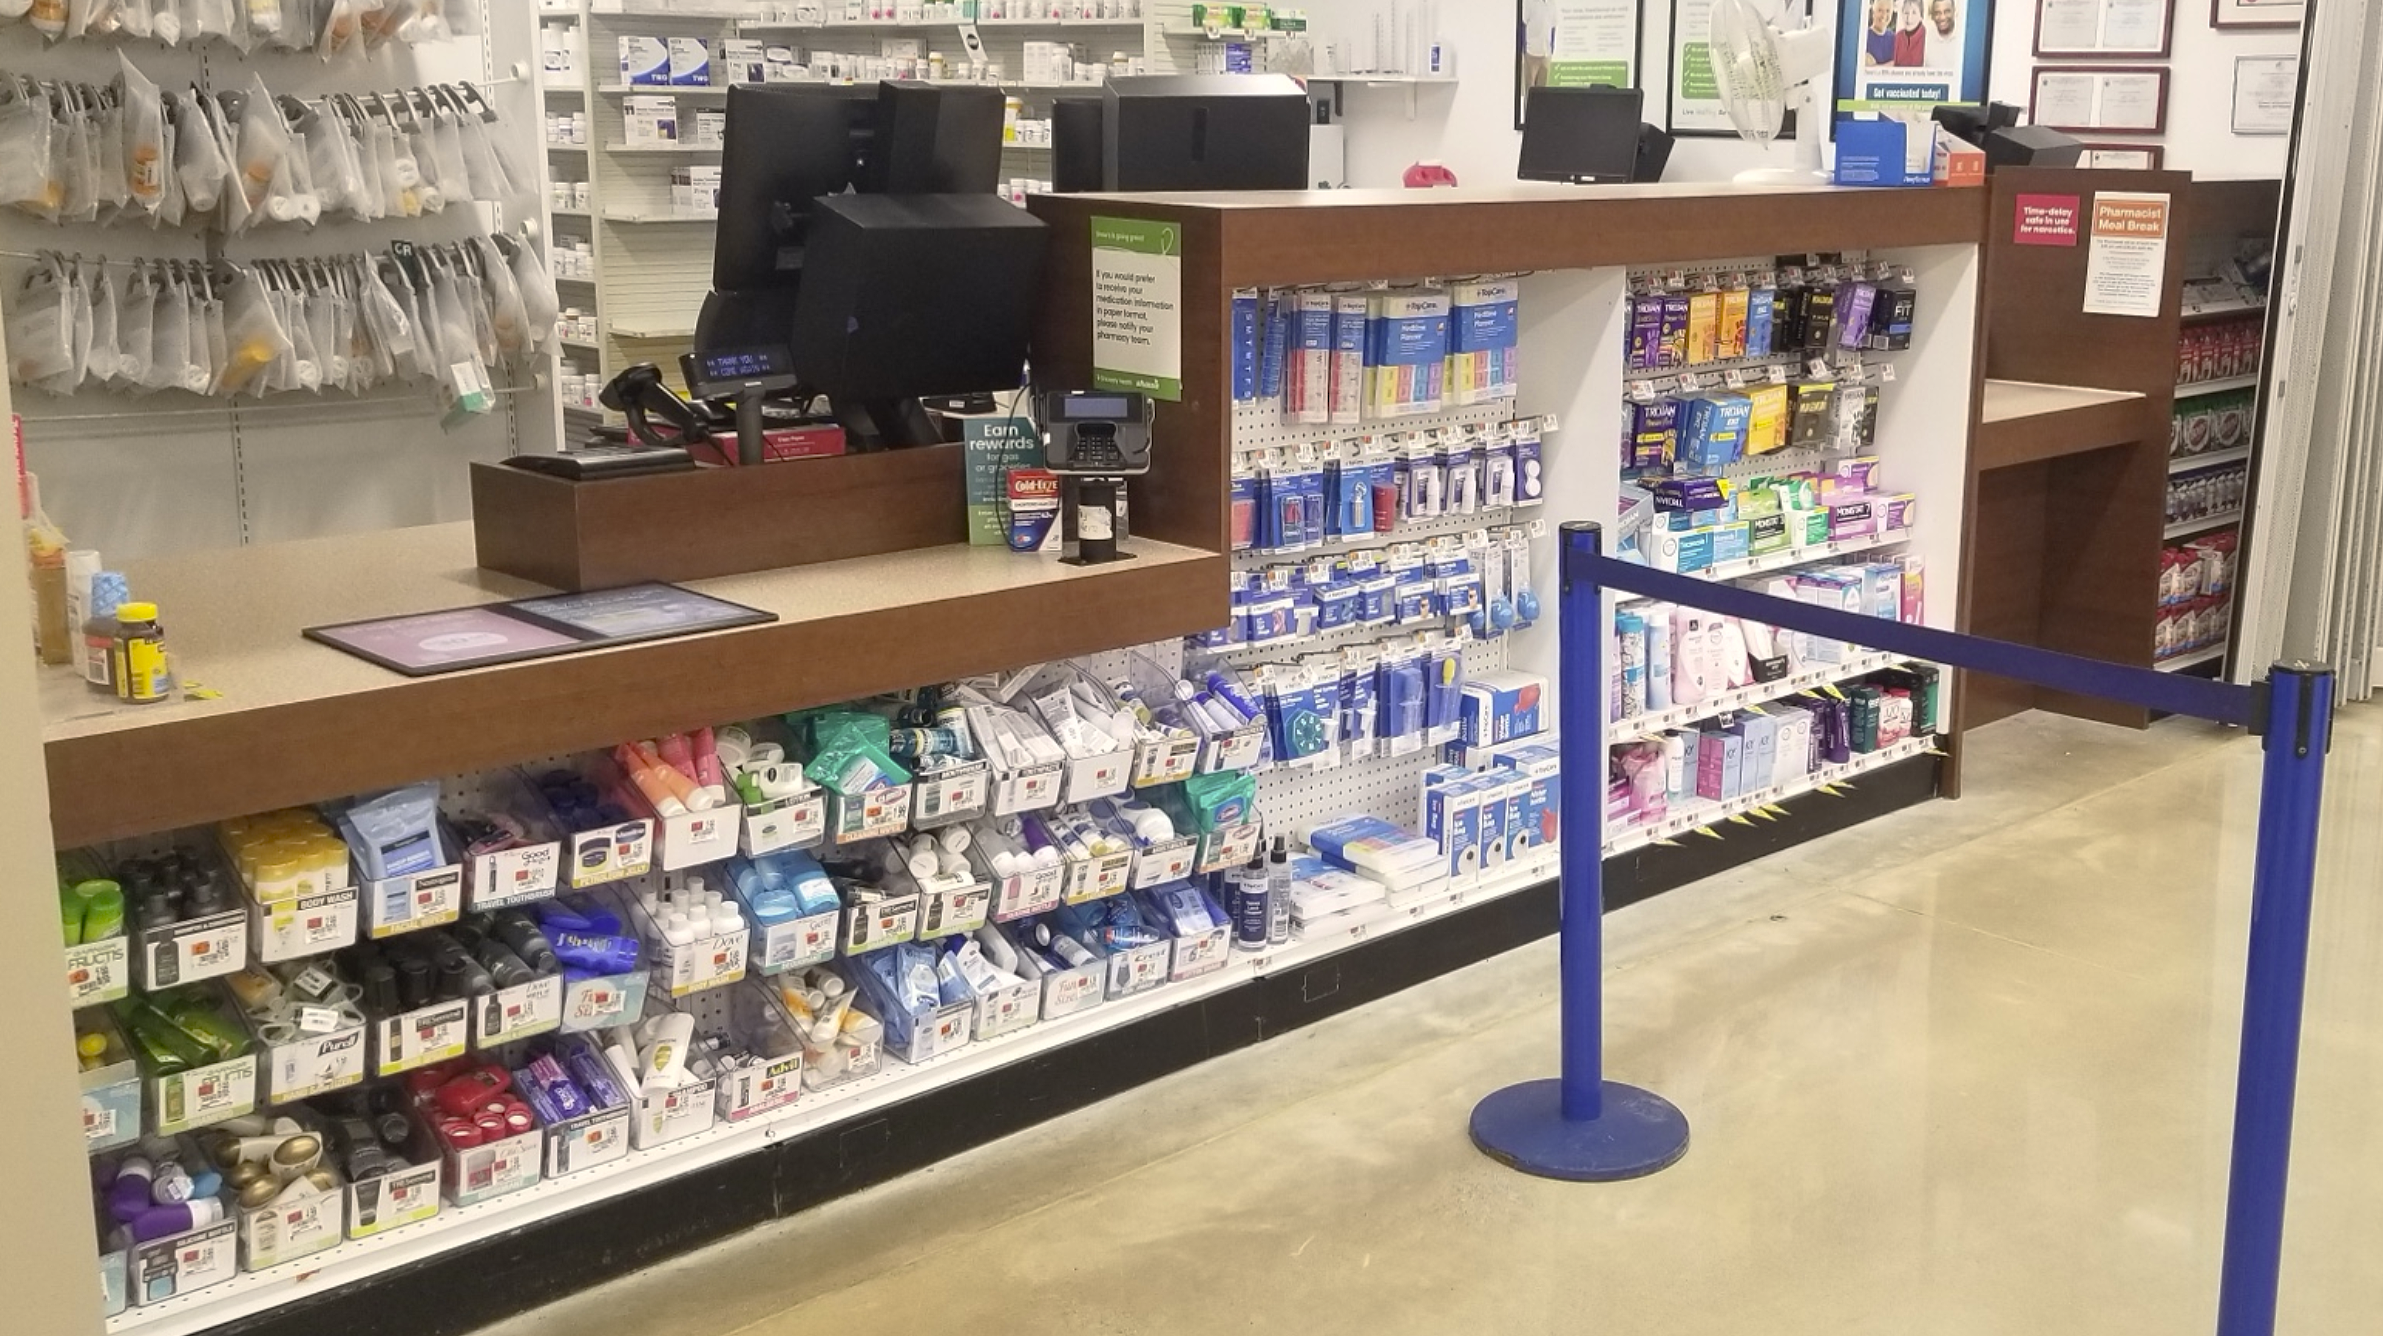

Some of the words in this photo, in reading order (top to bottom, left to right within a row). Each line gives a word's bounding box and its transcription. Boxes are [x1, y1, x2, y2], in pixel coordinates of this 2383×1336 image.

[1874, 88, 1884, 98] Get
[1886, 88, 1920, 98] vaccinated
[1921, 88, 1942, 100] today!
[2023, 206, 2072, 218] Time-delay
[2099, 205, 2162, 219] Pharmacist
[2025, 216, 2044, 225] safe
[2045, 216, 2053, 225] in
[2099, 219, 2125, 230] Meal
[2127, 220, 2160, 232] Break
[2020, 225, 2032, 233] for
[2032, 225, 2076, 234] narcotics.
[1101, 271, 1114, 281] you
[1114, 271, 1134, 282] would
[1135, 273, 1156, 284] prefer
[1103, 283, 1128, 293] receive
[1128, 286, 1144, 296] your
[1481, 288, 1506, 297] TopCare
[1096, 294, 1133, 306] medication
[1134, 297, 1174, 311] information
[1410, 301, 1437, 311] TopCare
[1637, 303, 1661, 313] TROJAN
[1665, 303, 1688, 312] TROJAN
[1103, 309, 1123, 319] paper
[1895, 305, 1912, 317] FIT
[1097, 319, 1117, 329] please
[1119, 321, 1137, 332] notify
[1138, 325, 1154, 334] your
[1097, 331, 1129, 344] pharmacy
[1643, 404, 1677, 419] TROJAN
[1720, 404, 1750, 417] TROJAN
[984, 424, 1018, 437] Earn
[970, 436, 1034, 451] rewards
[986, 452, 999, 461] for
[1001, 454, 1020, 463] gas
[976, 464, 987, 472] or
[1454, 819, 1463, 827] Ice
[1454, 827, 1466, 835] Bag
[521, 849, 550, 861] Good
[300, 898, 325, 911] BODY
[326, 890, 353, 905] WASH
[476, 900, 504, 911] TRAVEL
[506, 889, 555, 905] TOOTHBRUSH
[713, 934, 744, 950] Dove
[67, 948, 125, 971] FRUCTIS
[1134, 948, 1167, 962] Crest
[322, 1032, 358, 1055] Purell
[767, 1058, 800, 1078] Advil
